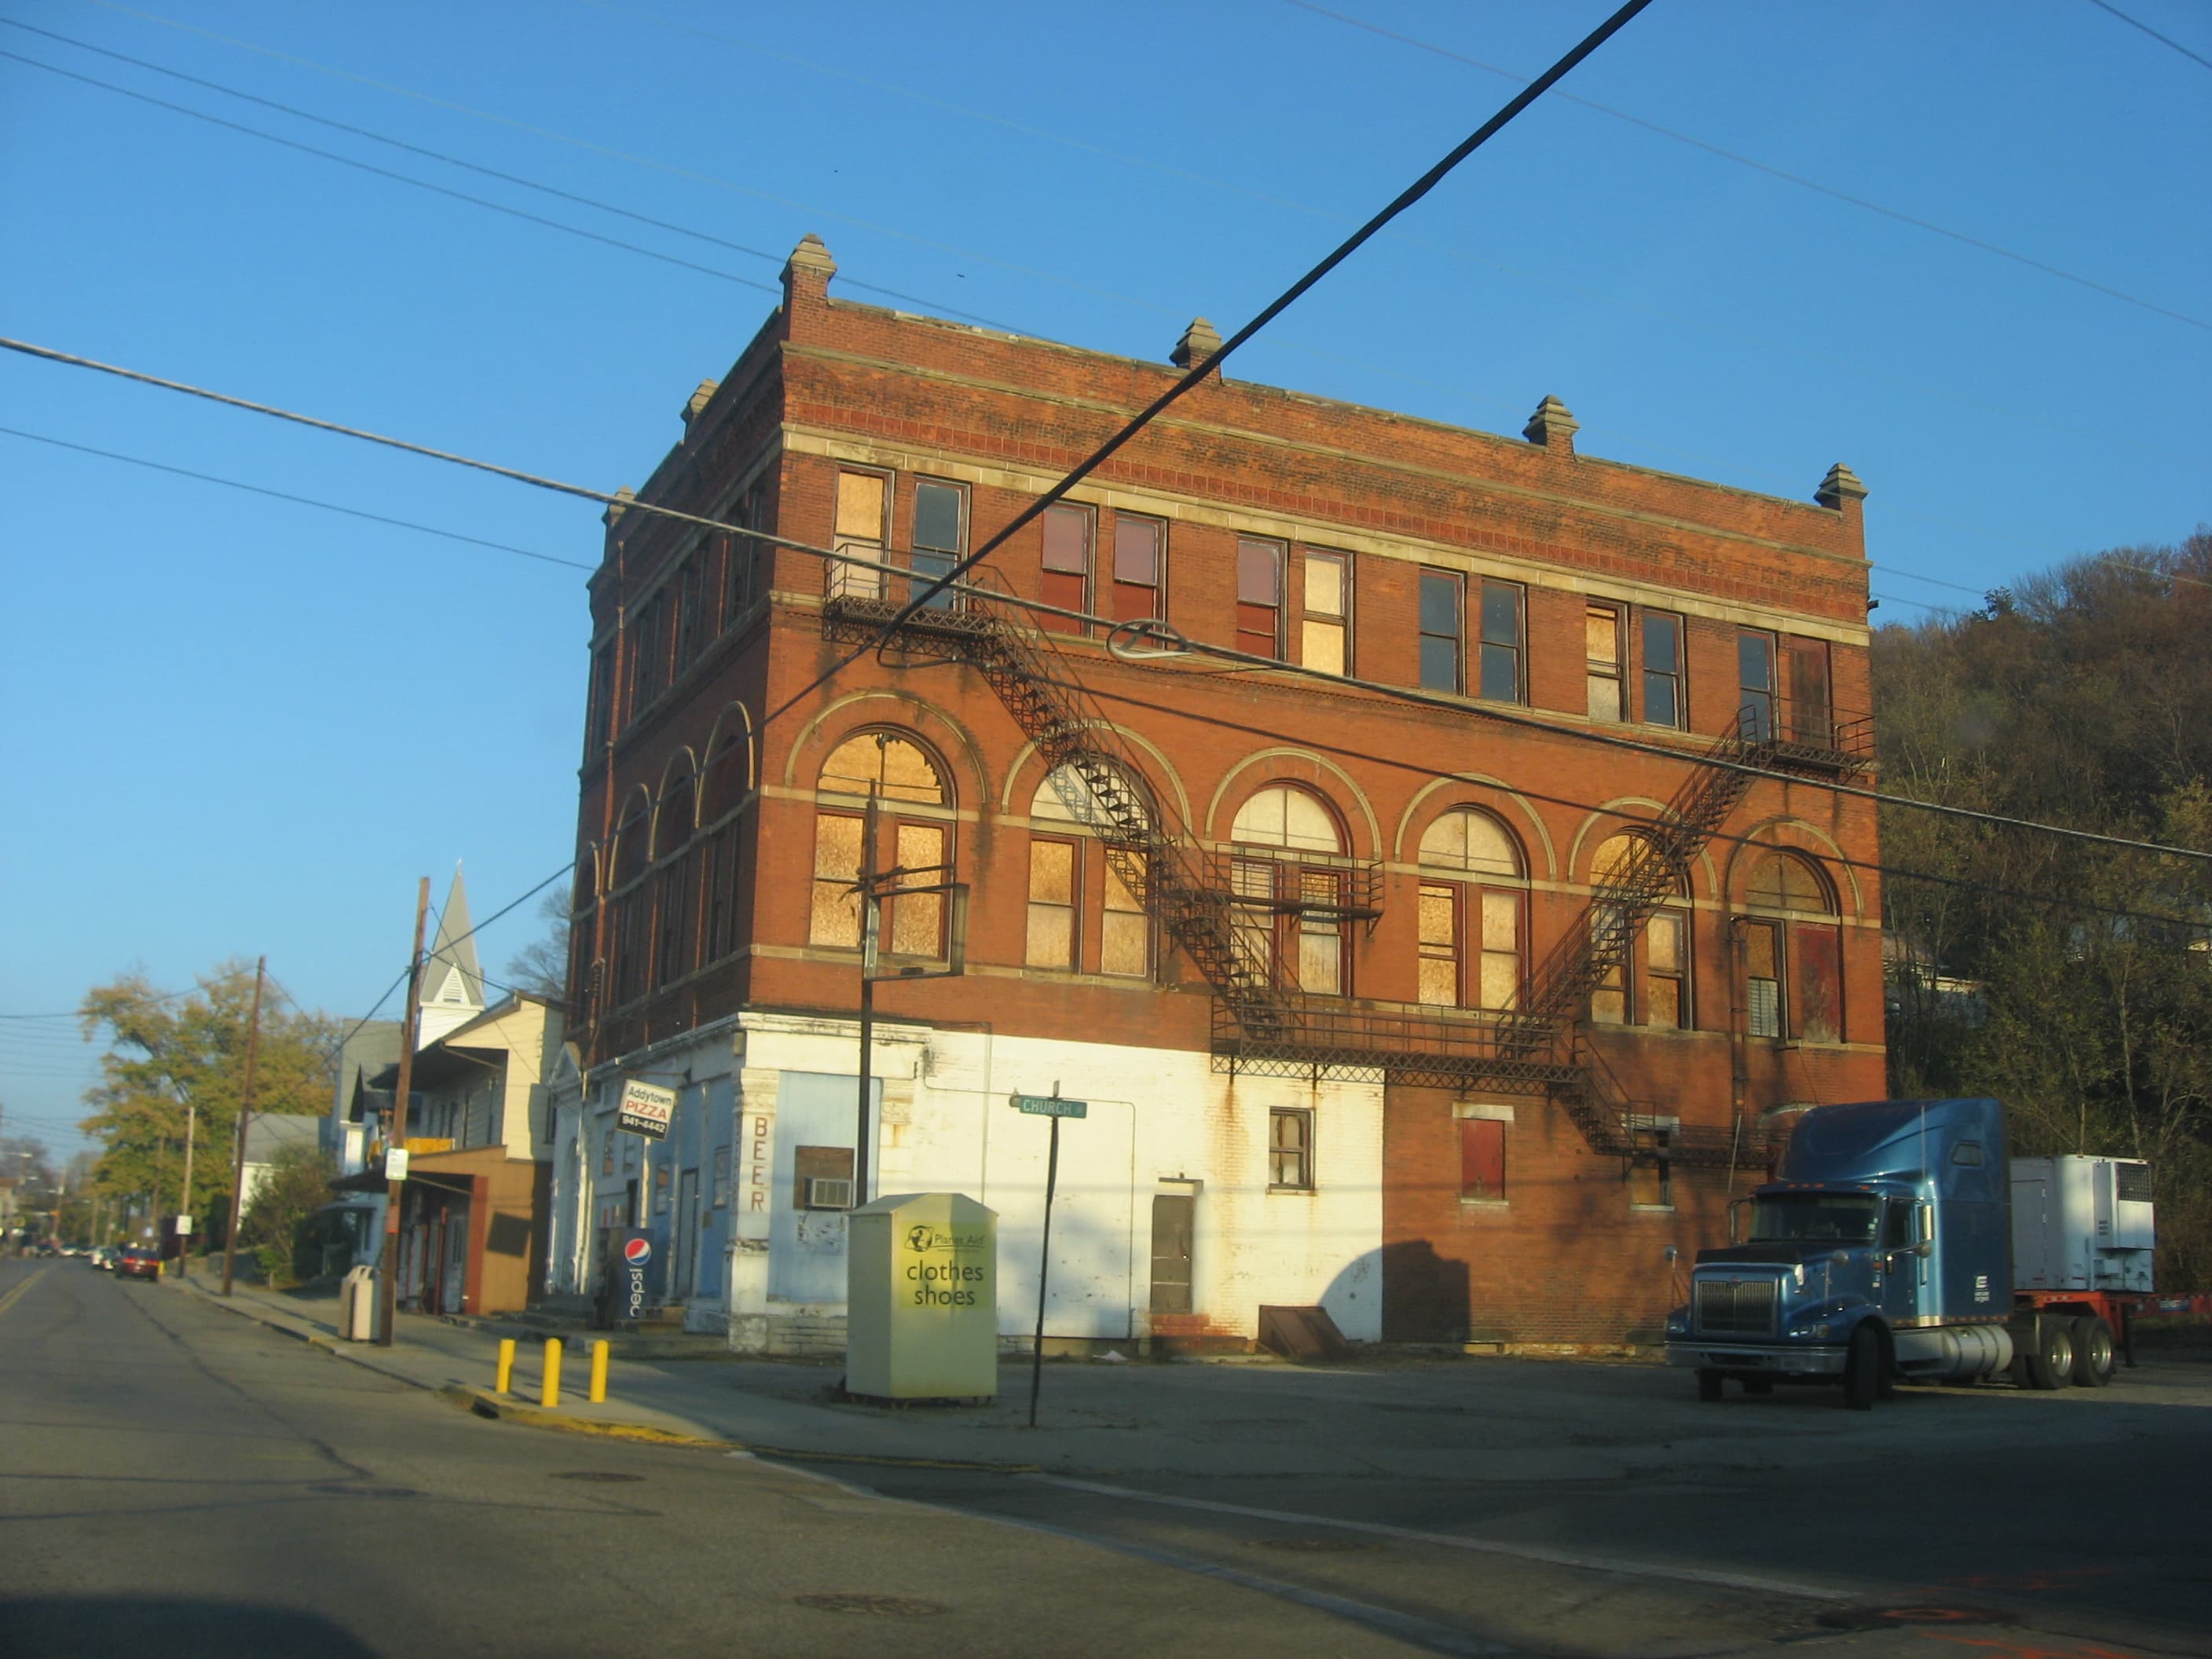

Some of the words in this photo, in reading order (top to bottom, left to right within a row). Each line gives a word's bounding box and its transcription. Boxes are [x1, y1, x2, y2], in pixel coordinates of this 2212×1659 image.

[628, 1086, 672, 1105] Addytown
[625, 1101, 667, 1119] PIZZA
[1023, 1100, 1072, 1115] CHURCH
[622, 1115, 665, 1133] 941-4442
[751, 1117, 767, 1212] BEER
[906, 1260, 984, 1281] clothes
[914, 1284, 976, 1305] shoes
